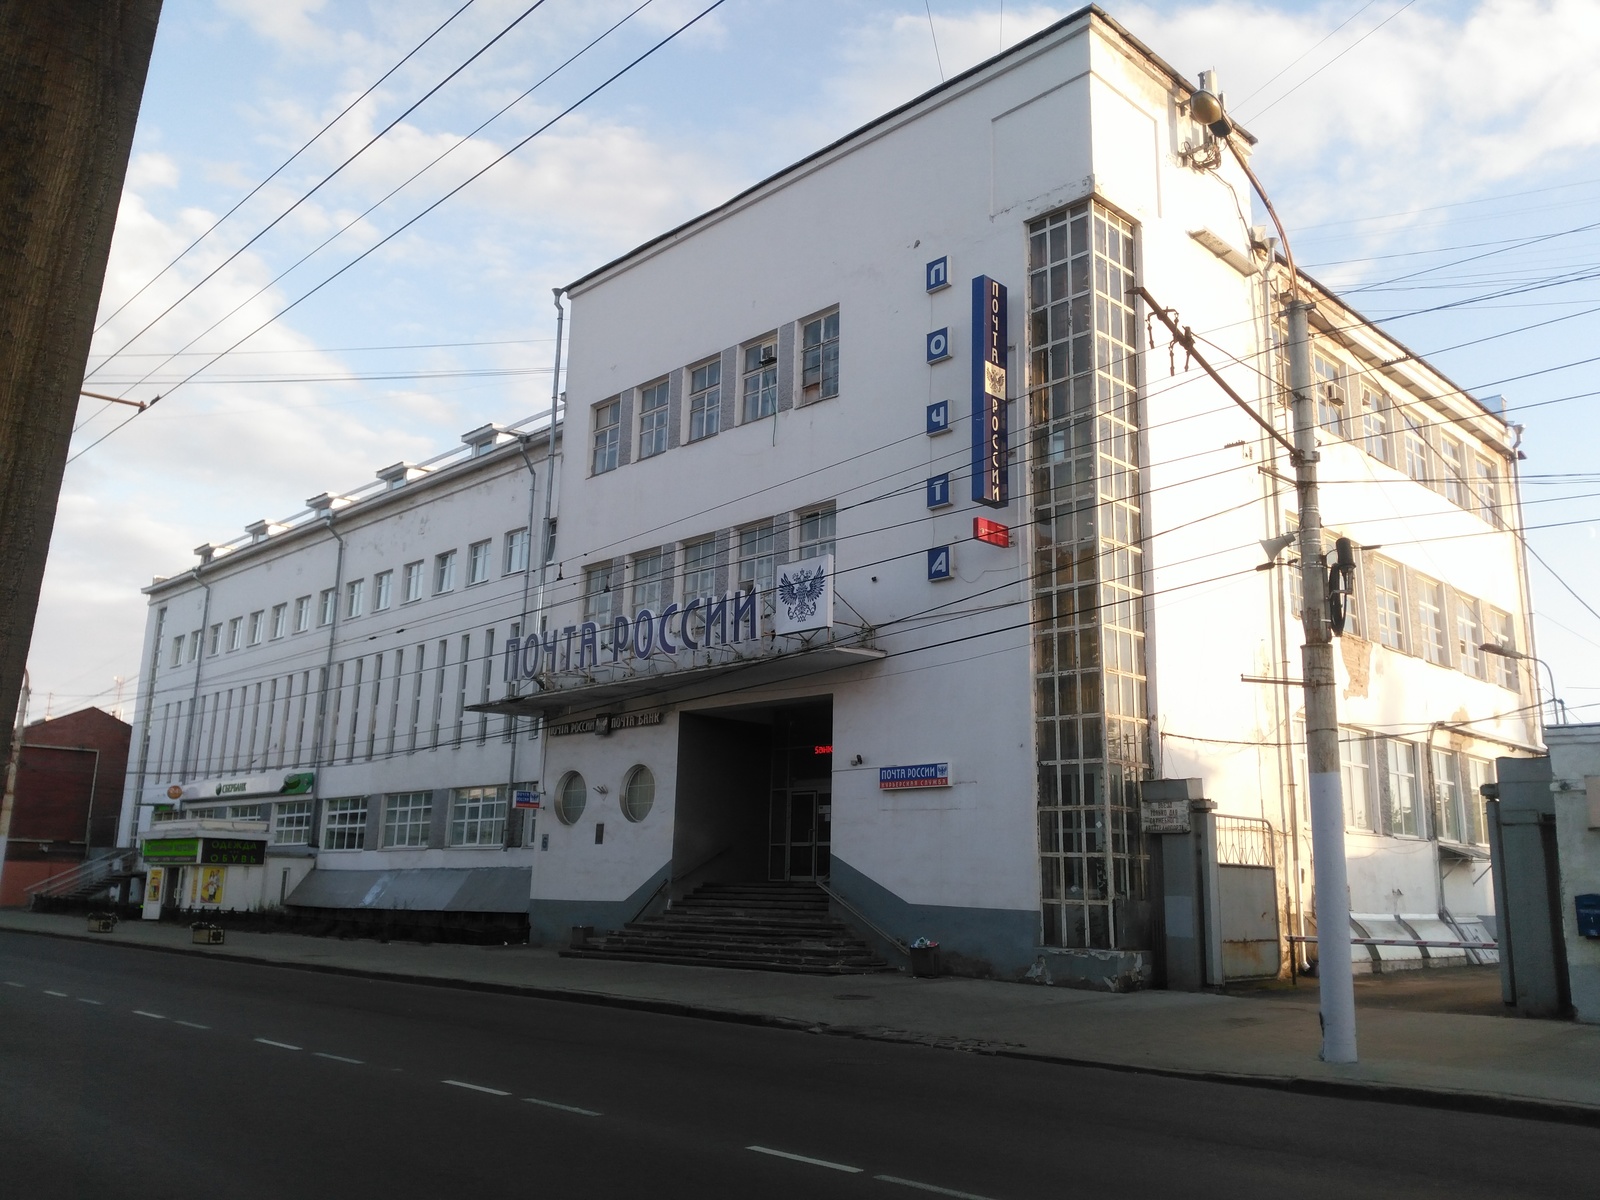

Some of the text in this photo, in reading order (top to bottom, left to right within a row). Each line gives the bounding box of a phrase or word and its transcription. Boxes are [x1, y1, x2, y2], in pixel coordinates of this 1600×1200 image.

[991, 281, 1000, 502] ПОЧТА РОССИИ
[930, 261, 946, 574] ПОЧТА
[504, 584, 762, 683] ПОЧТА РОССИИ
[550, 719, 595, 736] ПОЧТА РОССИИ
[611, 712, 660, 729] ПОЧТА БАНК
[881, 766, 935, 780] ПОЧТА РОССИИ
[222, 782, 247, 793] СБЕРБАНК
[881, 778, 947, 788] КУРЬЕРСКАЯ СЛУЖБА
[211, 840, 257, 850] ОДЕЖДА
[210, 854, 257, 863] ОБУВЬ
